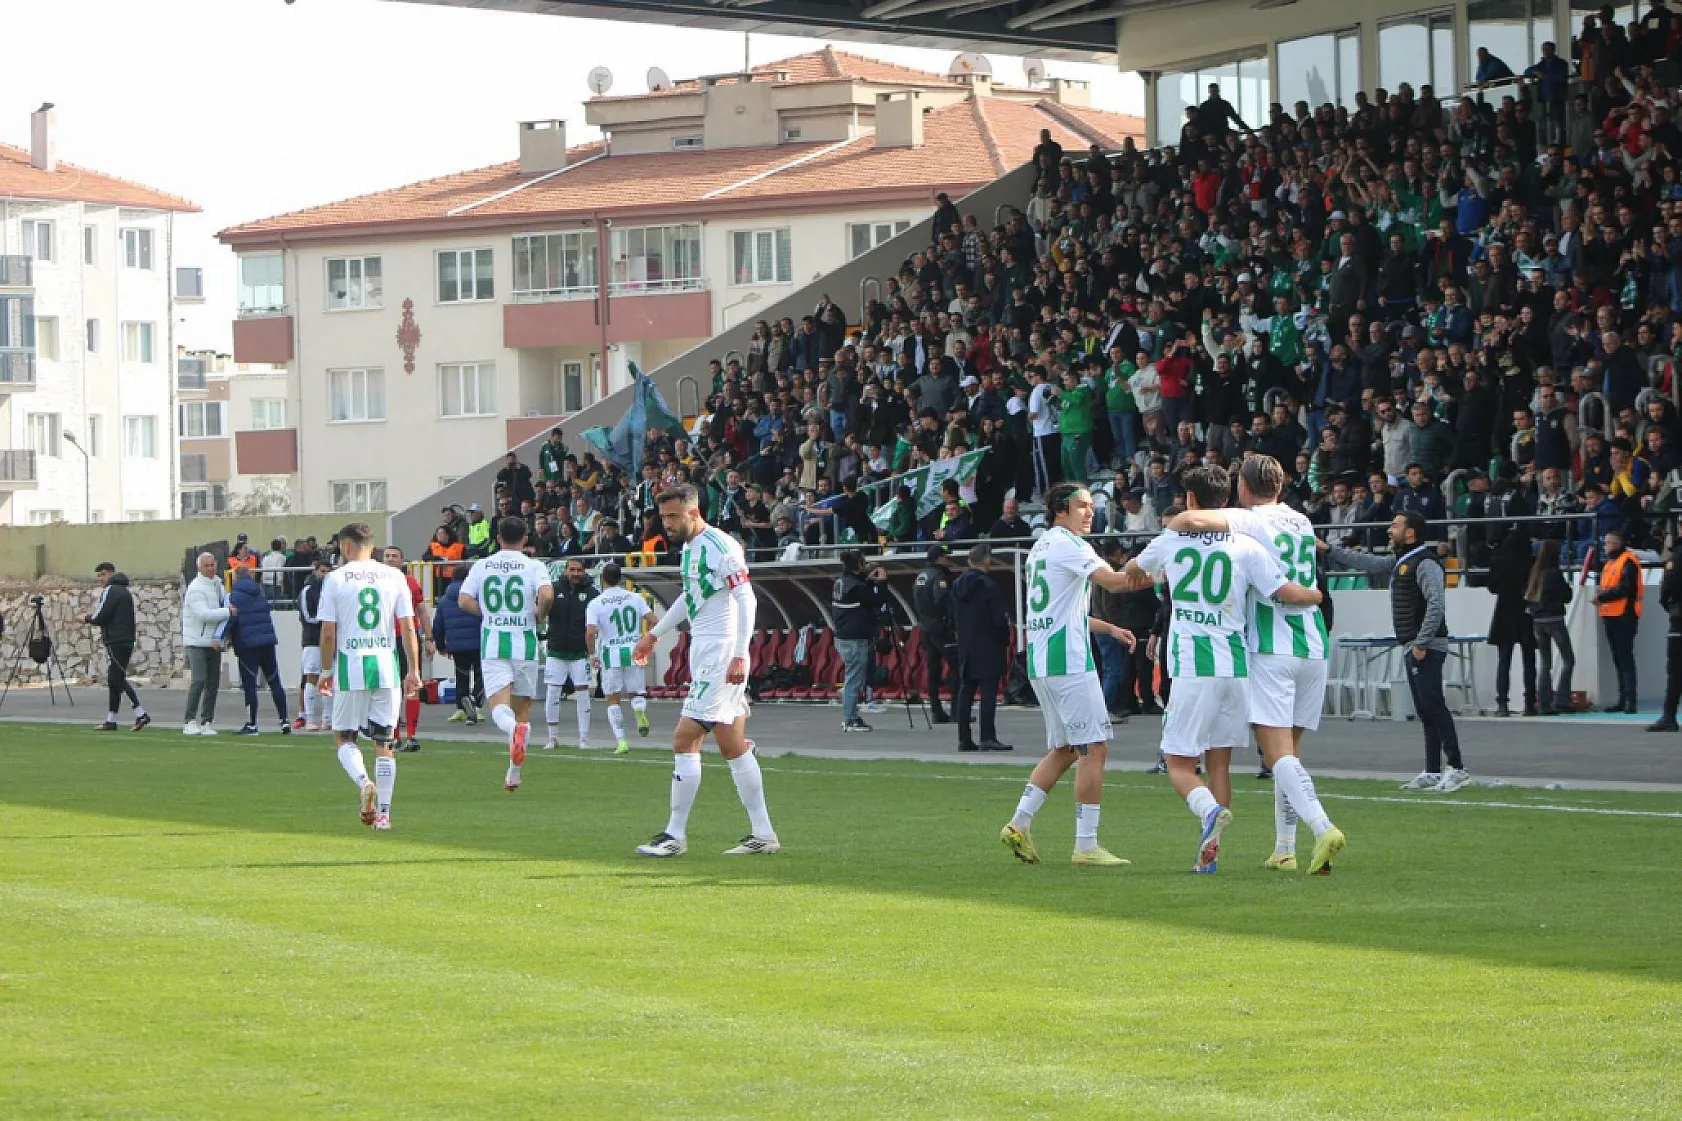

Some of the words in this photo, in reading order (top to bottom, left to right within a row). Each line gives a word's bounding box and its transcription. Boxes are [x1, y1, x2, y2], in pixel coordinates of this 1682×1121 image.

[1173, 546, 1232, 605] 20
[1274, 533, 1316, 588] 35
[357, 587, 380, 631] 8
[484, 574, 524, 613] 66
[609, 604, 637, 637] 10
